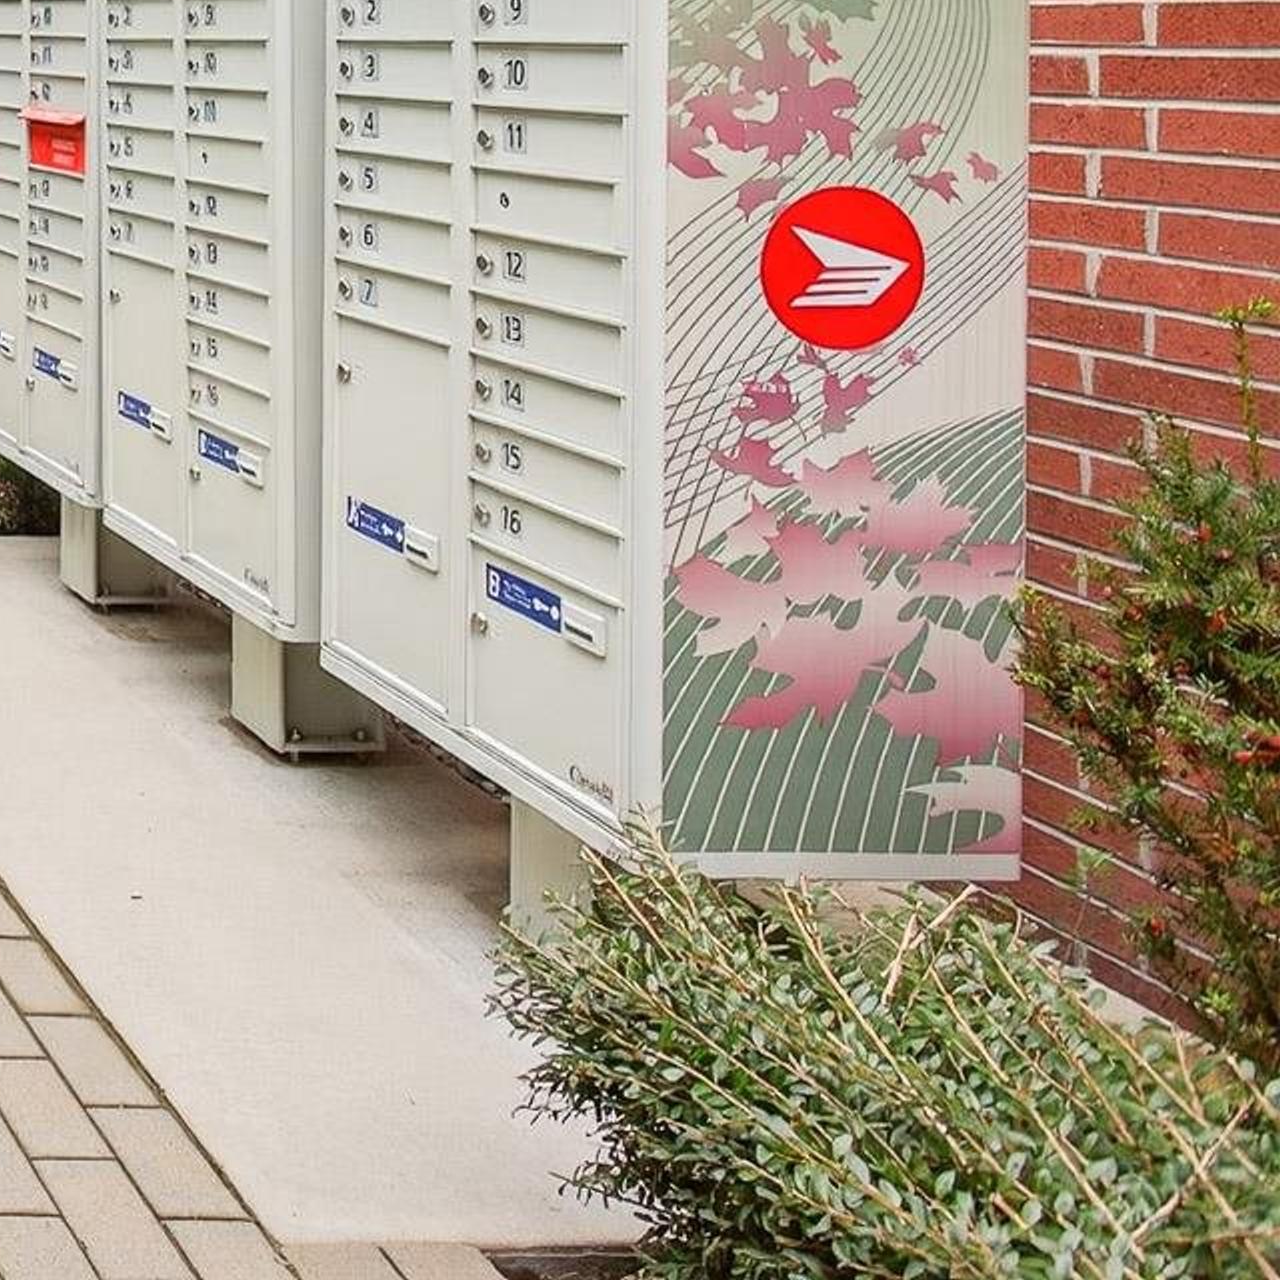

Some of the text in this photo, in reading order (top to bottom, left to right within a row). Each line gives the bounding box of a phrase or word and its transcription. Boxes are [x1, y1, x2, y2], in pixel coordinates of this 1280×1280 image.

[366, 53, 376, 78] 3
[503, 58, 526, 87] 10
[363, 111, 375, 132] 4
[506, 121, 523, 150] 11
[363, 166, 375, 190] 5
[363, 223, 374, 246] 6
[505, 250, 523, 278] 12
[363, 278, 374, 302] 7
[504, 315, 522, 343] 13
[503, 378, 522, 406] 14
[501, 441, 522, 471] 15
[500, 504, 522, 535] 16
